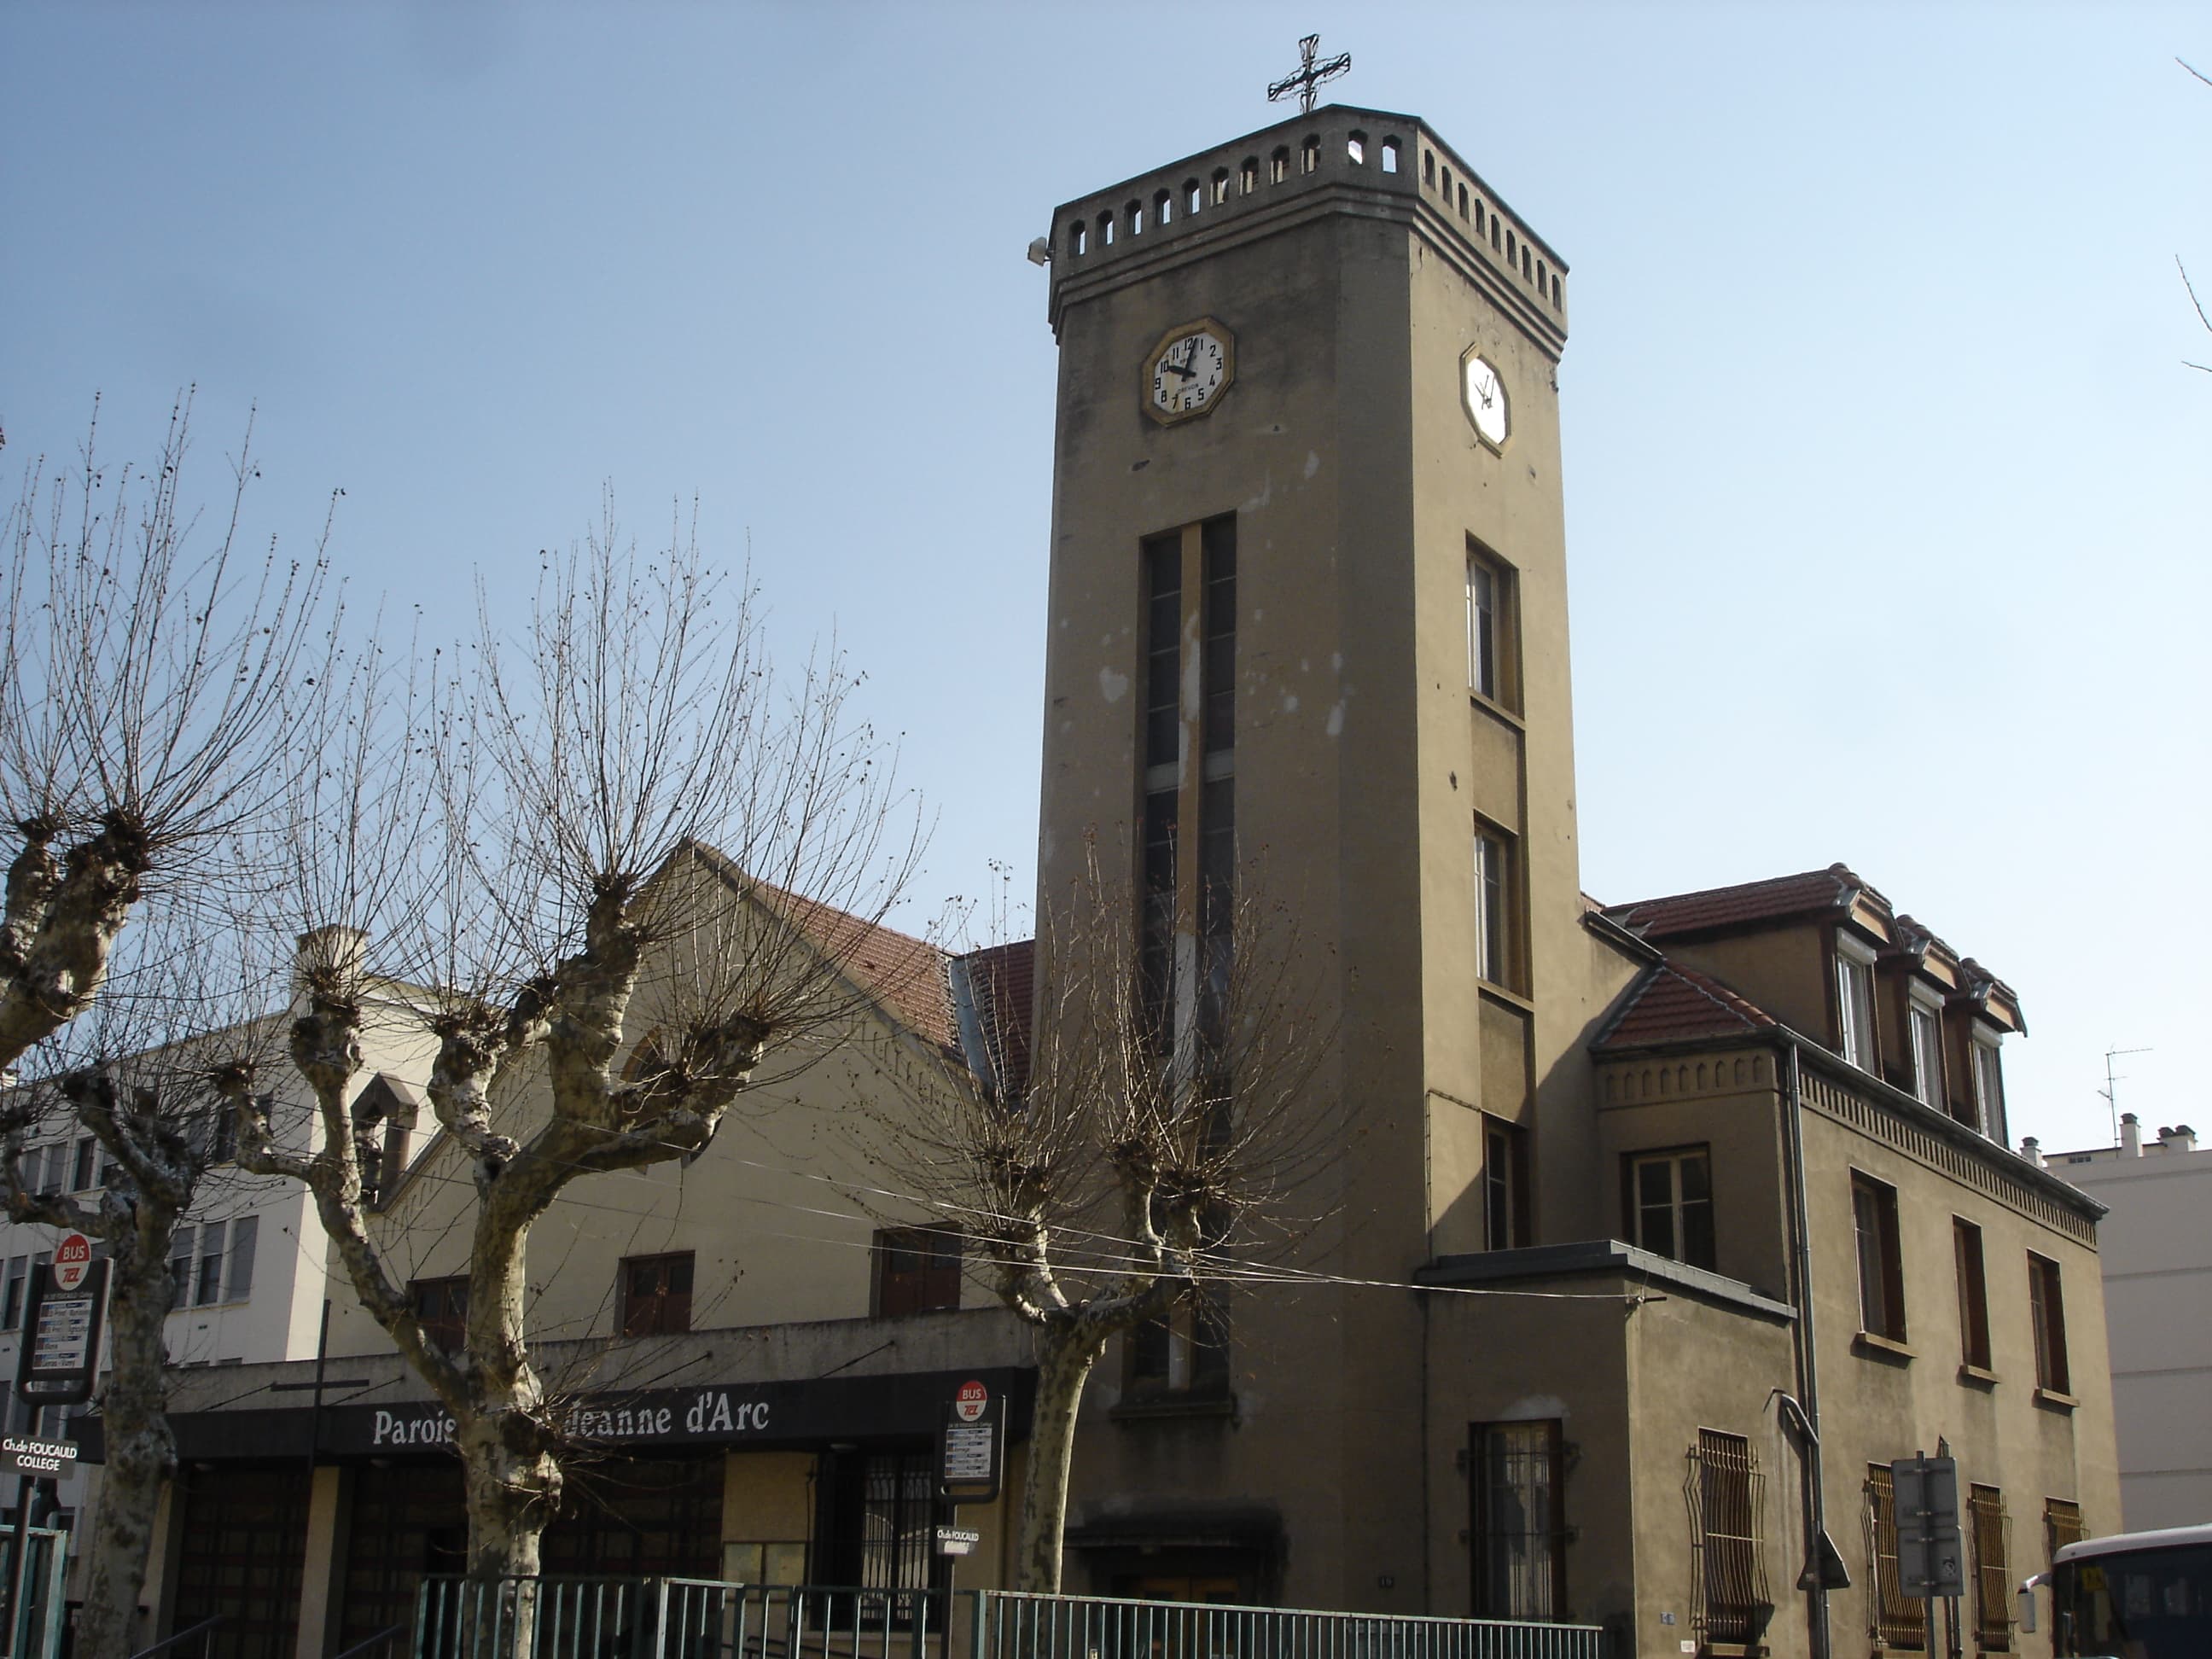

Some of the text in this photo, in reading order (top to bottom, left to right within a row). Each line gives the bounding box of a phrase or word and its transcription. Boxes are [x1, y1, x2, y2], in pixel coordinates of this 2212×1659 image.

[1185, 337, 1194, 351] 12
[1200, 338, 1204, 351] 1
[1173, 347, 1179, 359] 11
[1209, 345, 1216, 358] 2
[1161, 359, 1169, 374] 10
[1215, 358, 1222, 370] 3
[1155, 377, 1161, 390] 9
[1209, 375, 1215, 387] 4
[1161, 390, 1167, 403] 8
[1197, 387, 1204, 401] 5
[1171, 393, 1179, 409] 7
[1185, 397, 1191, 410] 6
[62, 1245, 84, 1260] BUS
[962, 1389, 981, 1400] BUS
[373, 1391, 770, 1445] Parois Jeanne d'Arc
[28, 1442, 78, 1458] FOUCAULD
[17, 1455, 61, 1471] COLLEGE
